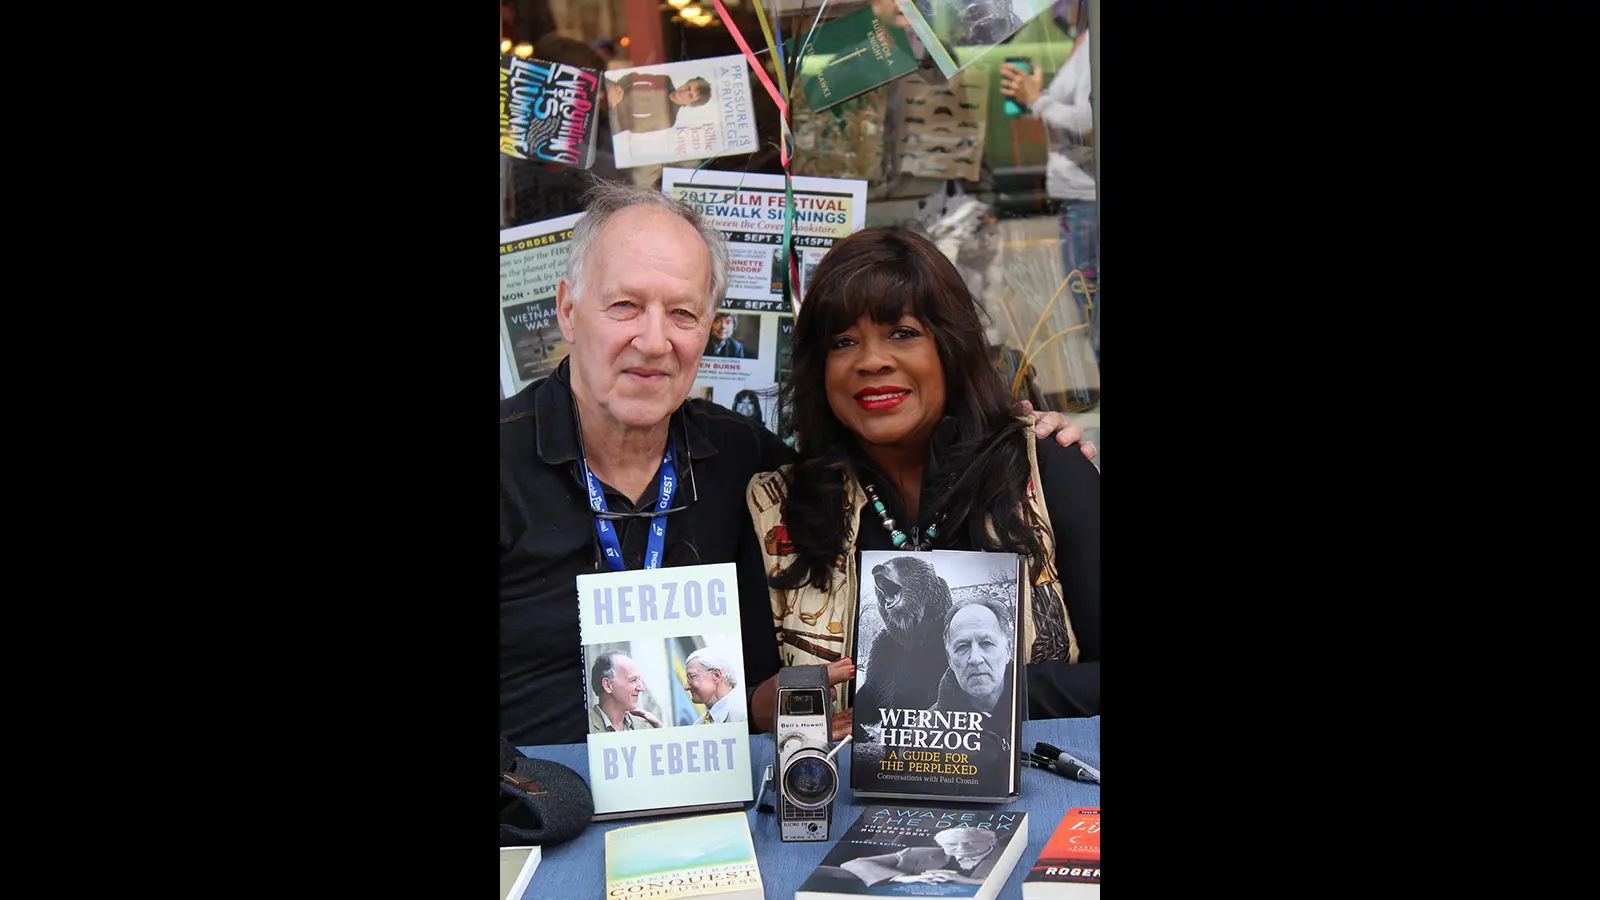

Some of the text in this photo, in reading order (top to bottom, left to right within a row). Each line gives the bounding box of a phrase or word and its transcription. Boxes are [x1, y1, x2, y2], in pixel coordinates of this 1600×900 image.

[719, 67, 729, 77] A
[534, 86, 558, 120] IS
[731, 65, 750, 129] PRESSURE
[721, 81, 738, 148] PRIVILEGE
[679, 191, 718, 204] 2017
[723, 193, 762, 206] FILM
[767, 209, 847, 225] SININGS
[738, 219, 756, 229] the
[757, 221, 784, 231] Cover
[744, 233, 772, 243] SEPT
[501, 291, 524, 302] MON
[525, 303, 540, 313] THE
[744, 300, 774, 310] SEPT
[525, 318, 550, 331] WAR
[660, 475, 673, 509] GUEST
[593, 578, 727, 626] HERZOG
[879, 708, 984, 731] WERNER
[879, 728, 981, 751] HERZOG
[603, 738, 737, 780] BY EBERT
[889, 750, 969, 764] A GUIDE FOR
[880, 760, 978, 776] THE PERPLEXED
[877, 772, 979, 785] Conversations with Paul Cronin
[875, 808, 1016, 822] AWAKE IN
[872, 816, 1013, 831] THE DARK
[610, 869, 756, 897] CONQUEST
